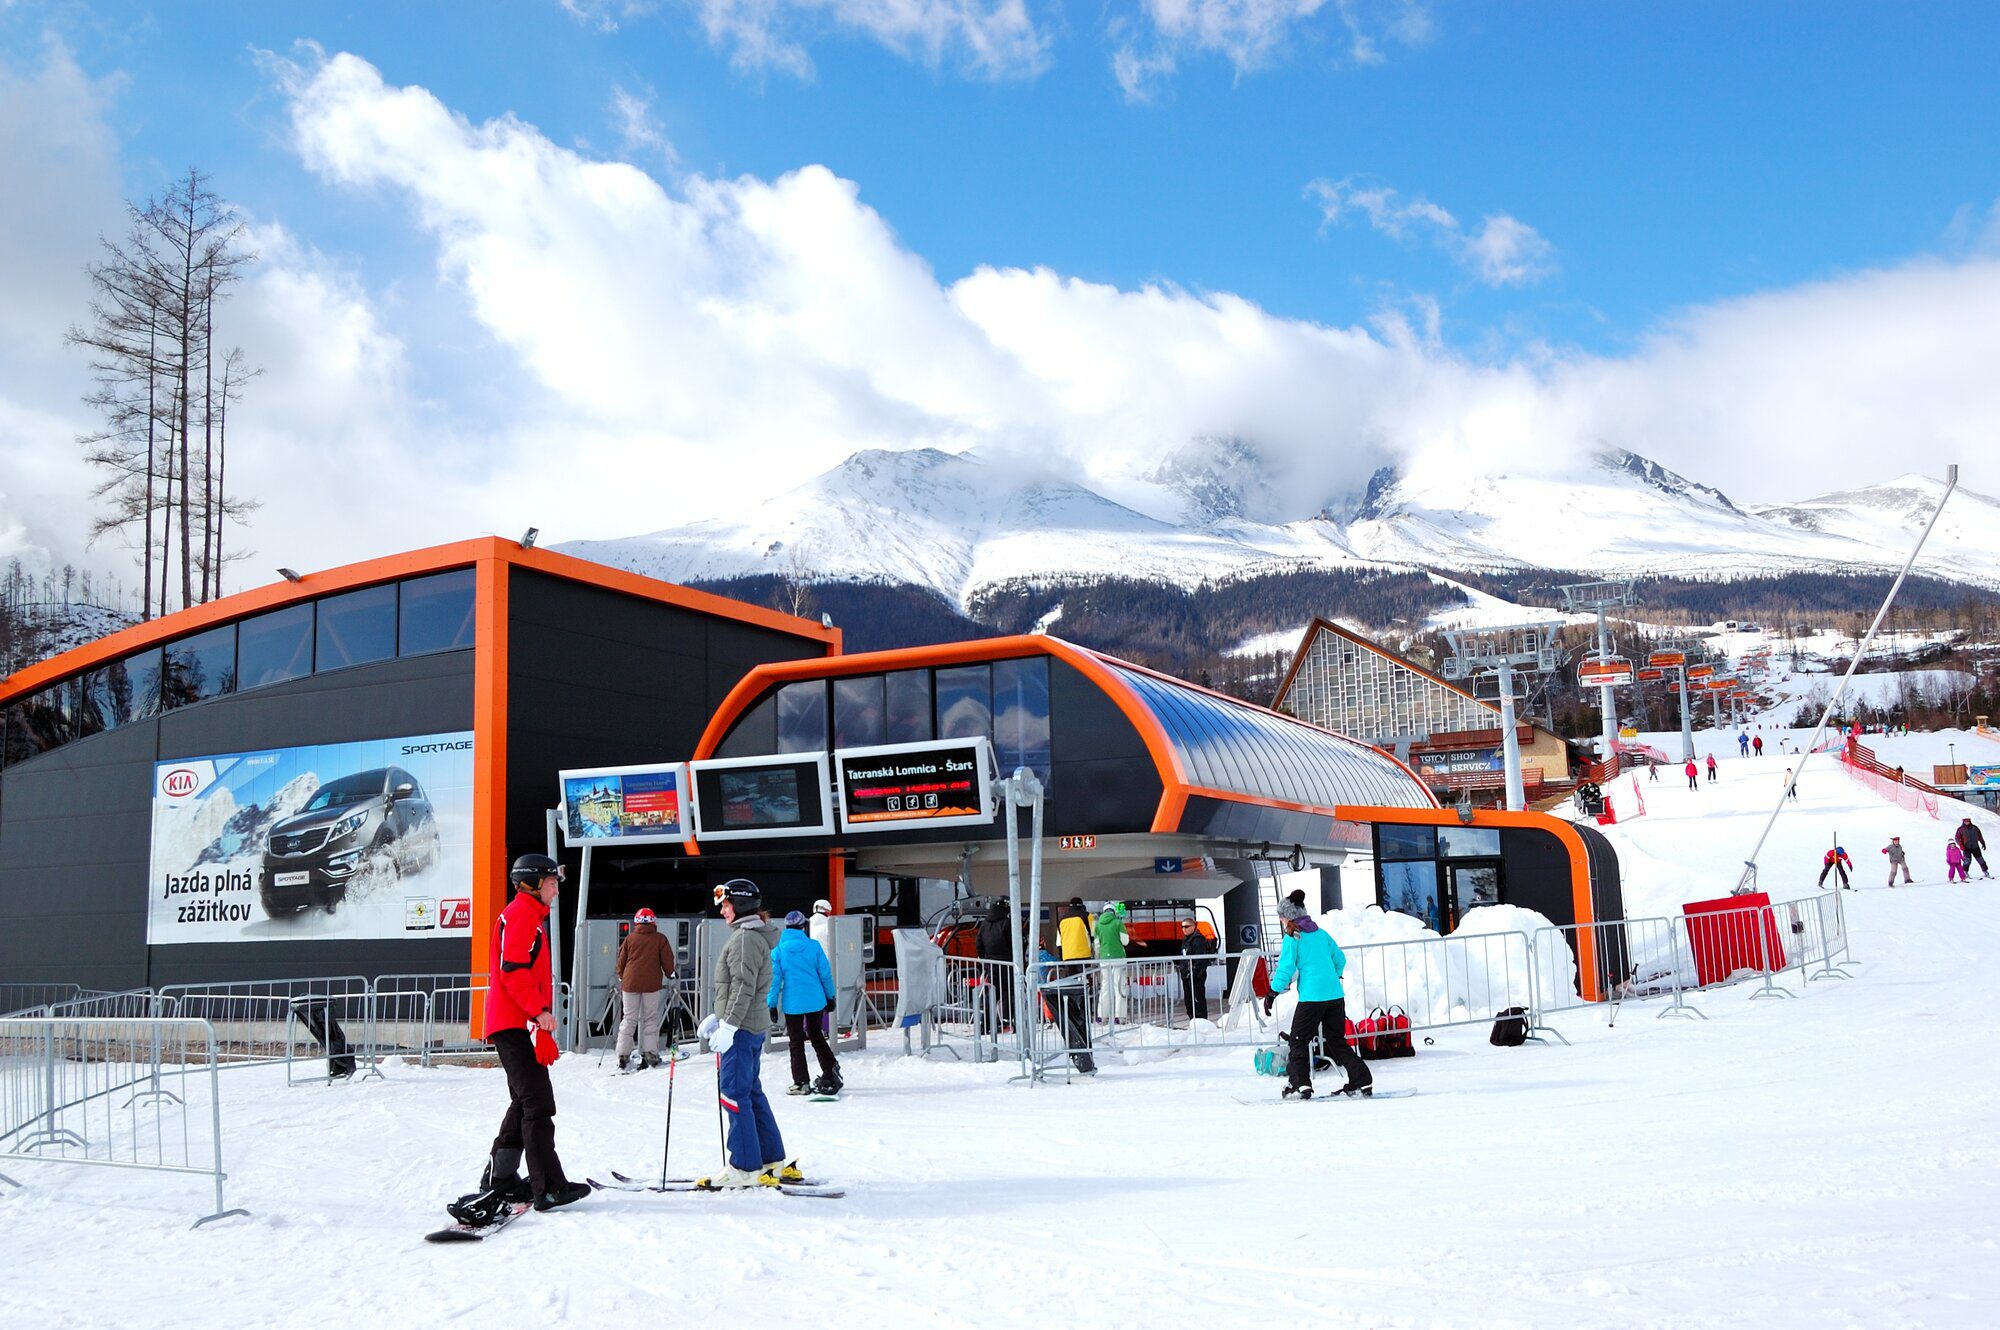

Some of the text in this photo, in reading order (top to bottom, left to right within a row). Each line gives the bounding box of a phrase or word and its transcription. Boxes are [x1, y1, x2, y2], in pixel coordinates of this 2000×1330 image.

[401, 741, 473, 755] SPORTAGE
[1450, 752, 1476, 761] SHOP
[847, 766, 894, 780] Tatranská
[896, 763, 937, 776] Lomnica
[946, 759, 974, 772] Štart
[1451, 762, 1491, 772] SERVICE
[169, 775, 192, 790] KIA
[164, 868, 251, 899] Jazda plná
[177, 900, 252, 923] zážitkov
[441, 901, 459, 925] 7
[455, 911, 469, 919] KIA
